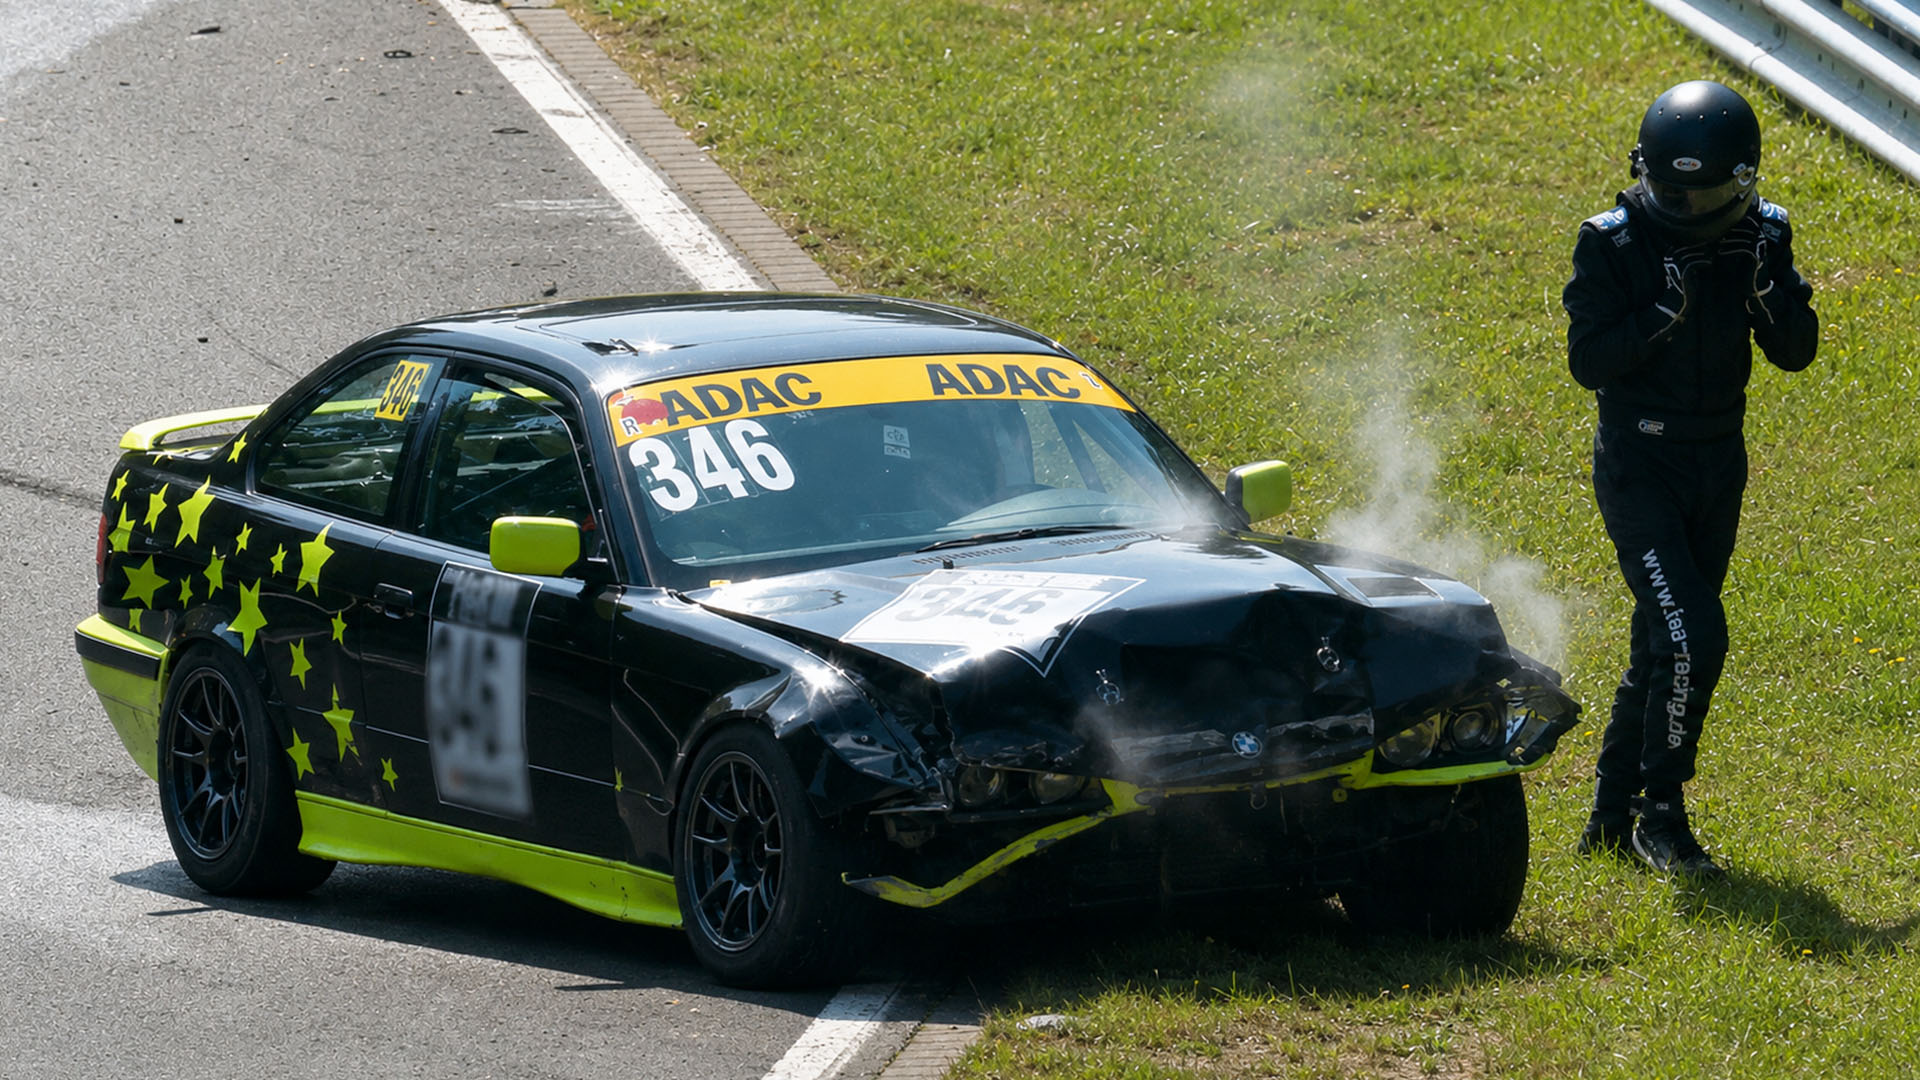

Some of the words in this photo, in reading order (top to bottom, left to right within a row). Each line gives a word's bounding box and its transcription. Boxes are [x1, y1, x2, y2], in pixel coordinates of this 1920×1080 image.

[379, 364, 425, 416] 346
[658, 373, 823, 427] ADAC
[925, 363, 1082, 399] ADAC
[628, 418, 796, 513] 346
